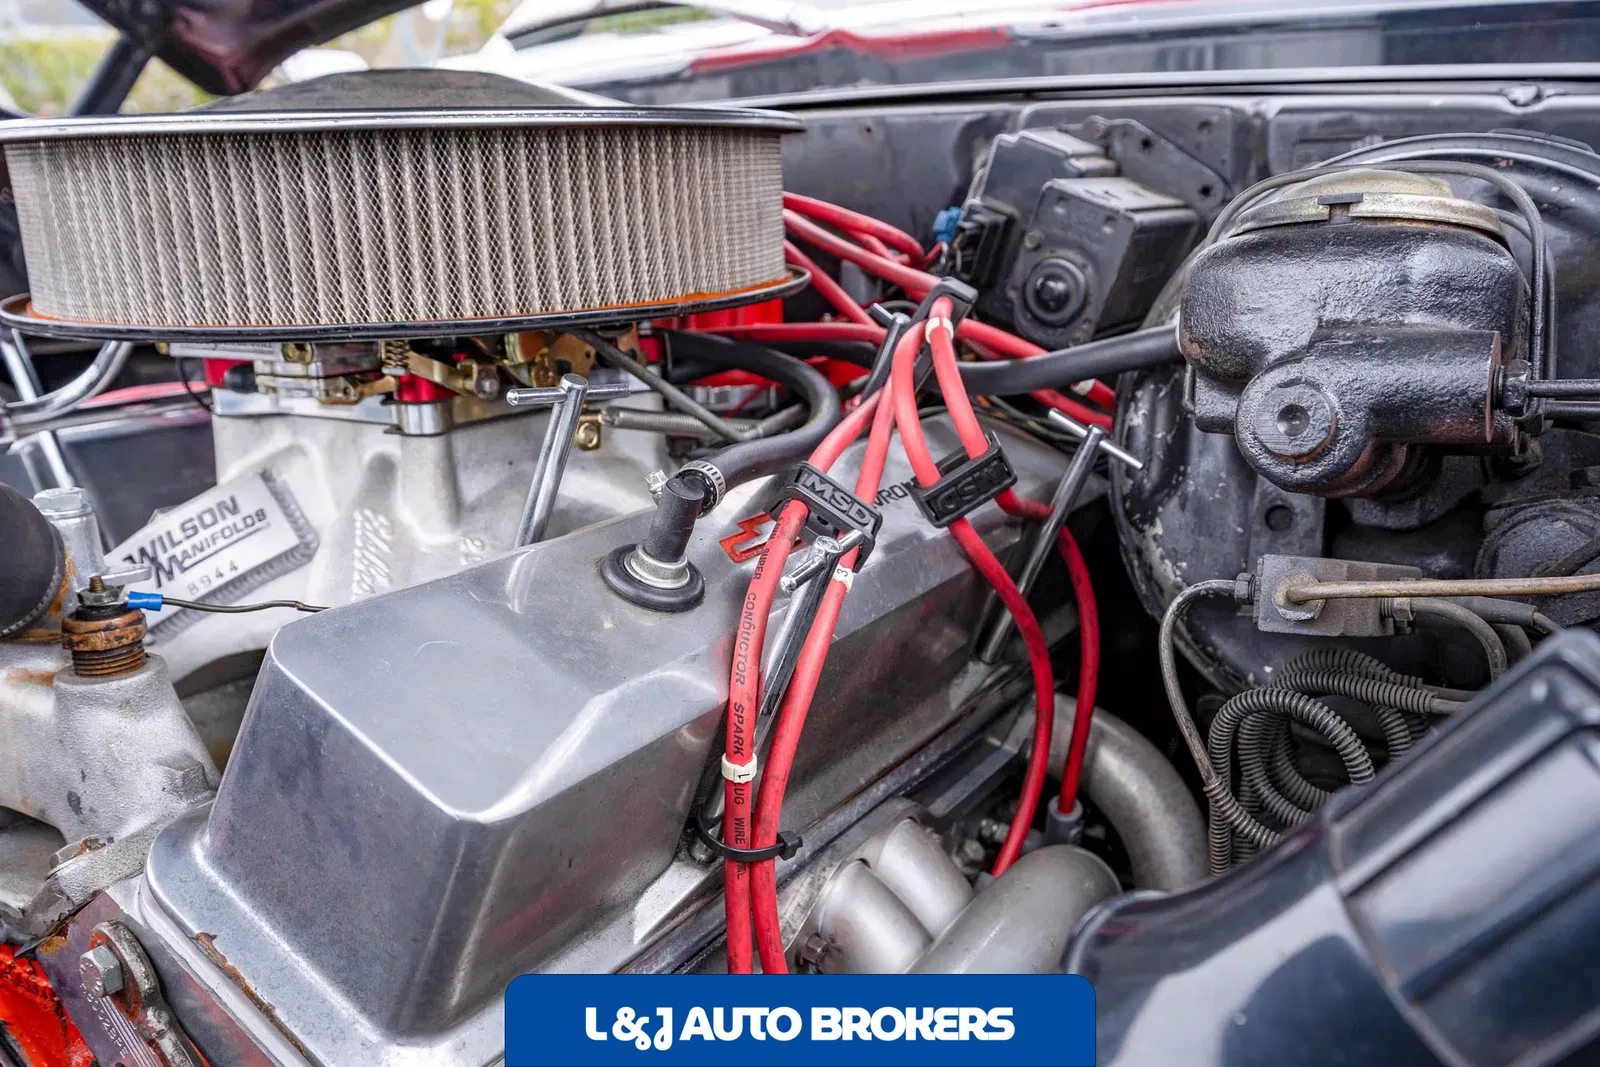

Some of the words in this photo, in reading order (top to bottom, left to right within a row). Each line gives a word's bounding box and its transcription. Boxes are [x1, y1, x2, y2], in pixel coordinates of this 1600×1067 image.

[803, 471, 871, 527] MSD
[122, 494, 241, 566] WILSON
[152, 507, 268, 589] MANIFOLDS
[752, 547, 771, 581] SUPER
[836, 568, 849, 578] 3
[735, 592, 757, 686] CONDUCTOR
[732, 702, 746, 758] SPARK
[733, 781, 746, 806] LUG
[733, 816, 747, 846] WIRE
